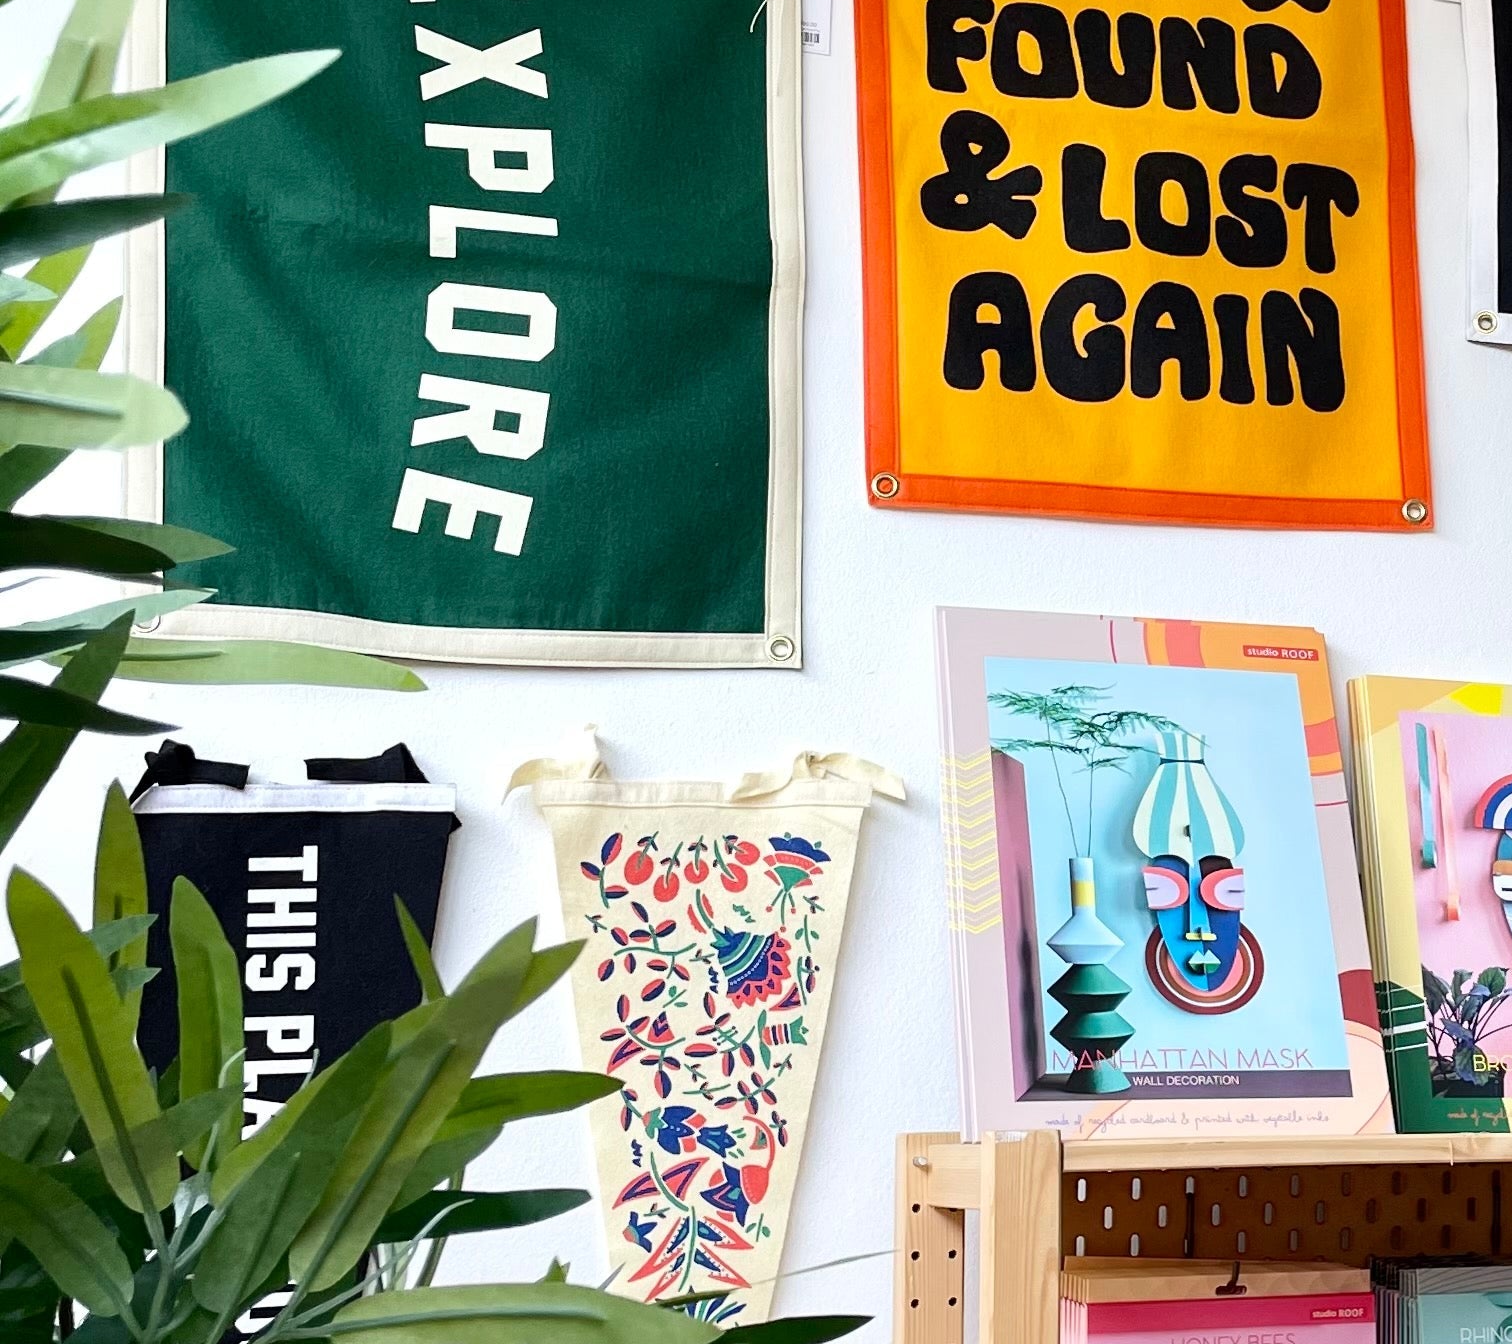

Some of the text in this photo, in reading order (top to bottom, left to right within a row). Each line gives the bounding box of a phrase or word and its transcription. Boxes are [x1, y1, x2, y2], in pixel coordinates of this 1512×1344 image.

[919, 110, 1360, 274] & LOST
[942, 271, 1346, 413] AGAIN
[1247, 647, 1315, 660] studio ROOF
[245, 845, 319, 992] THIS
[1052, 1048, 1314, 1071] MANHATTAN MASK
[1132, 1075, 1240, 1087] WALL DECORATION
[1338, 1308, 1364, 1318] ROOF
